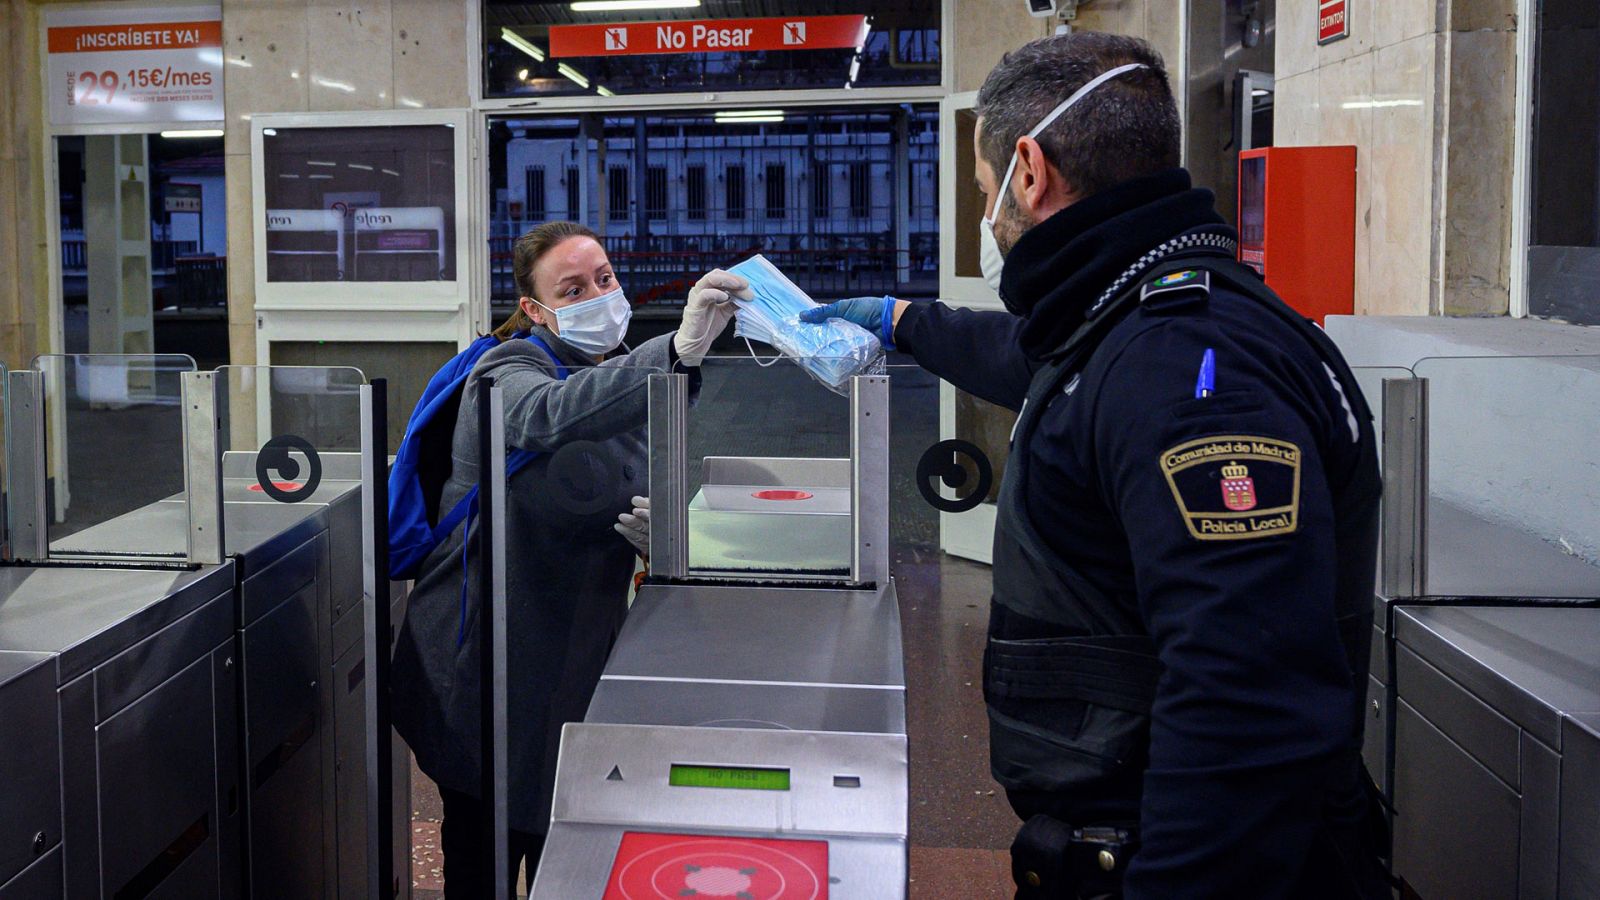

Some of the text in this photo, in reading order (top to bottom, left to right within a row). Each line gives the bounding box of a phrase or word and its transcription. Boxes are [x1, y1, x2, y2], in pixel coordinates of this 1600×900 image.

[1321, 10, 1344, 30] EXTINTOR
[76, 27, 200, 50] ¡INSCRÍBETE YA!
[656, 25, 753, 49] No Pasar
[67, 71, 76, 106] DESDE
[1167, 442, 1297, 467] Comunidad de Madrid
[1250, 514, 1290, 531] Local
[708, 770, 723, 780] NO
